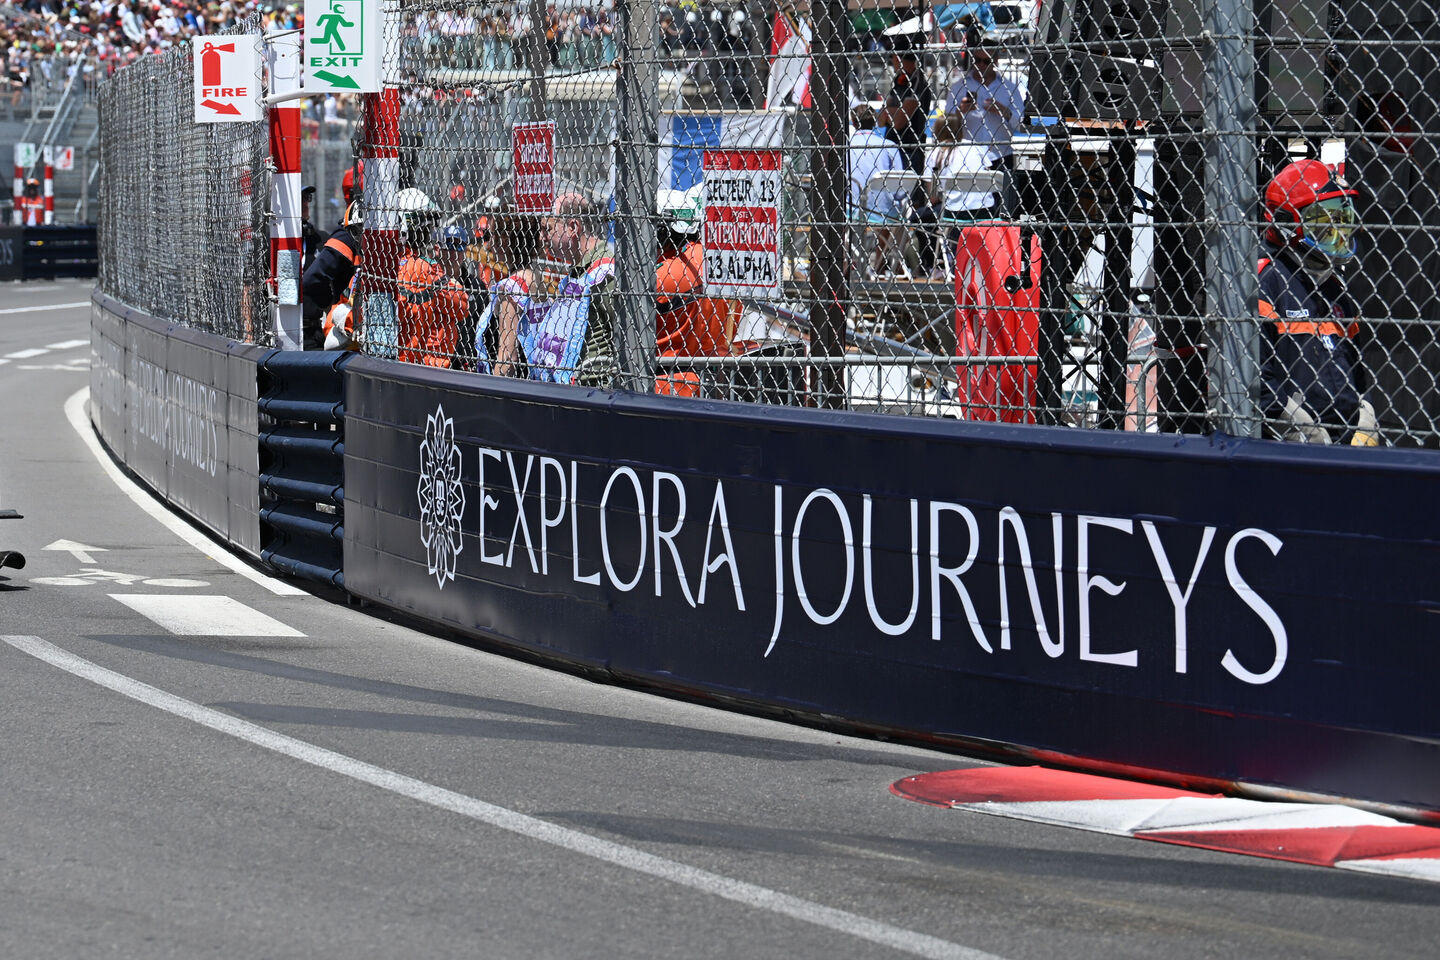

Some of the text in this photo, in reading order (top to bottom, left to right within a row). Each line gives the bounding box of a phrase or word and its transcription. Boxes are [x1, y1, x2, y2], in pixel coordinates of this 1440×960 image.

[310, 56, 363, 67] EXIT
[202, 87, 247, 98] FIRE
[706, 179, 775, 203] SECTEUR 13
[706, 220, 775, 246] INTERVENTION
[707, 255, 773, 281] 13 ALPHA
[171, 374, 217, 478] JOURNEYS
[478, 447, 1288, 685] EXPLORA JOURNEYS
